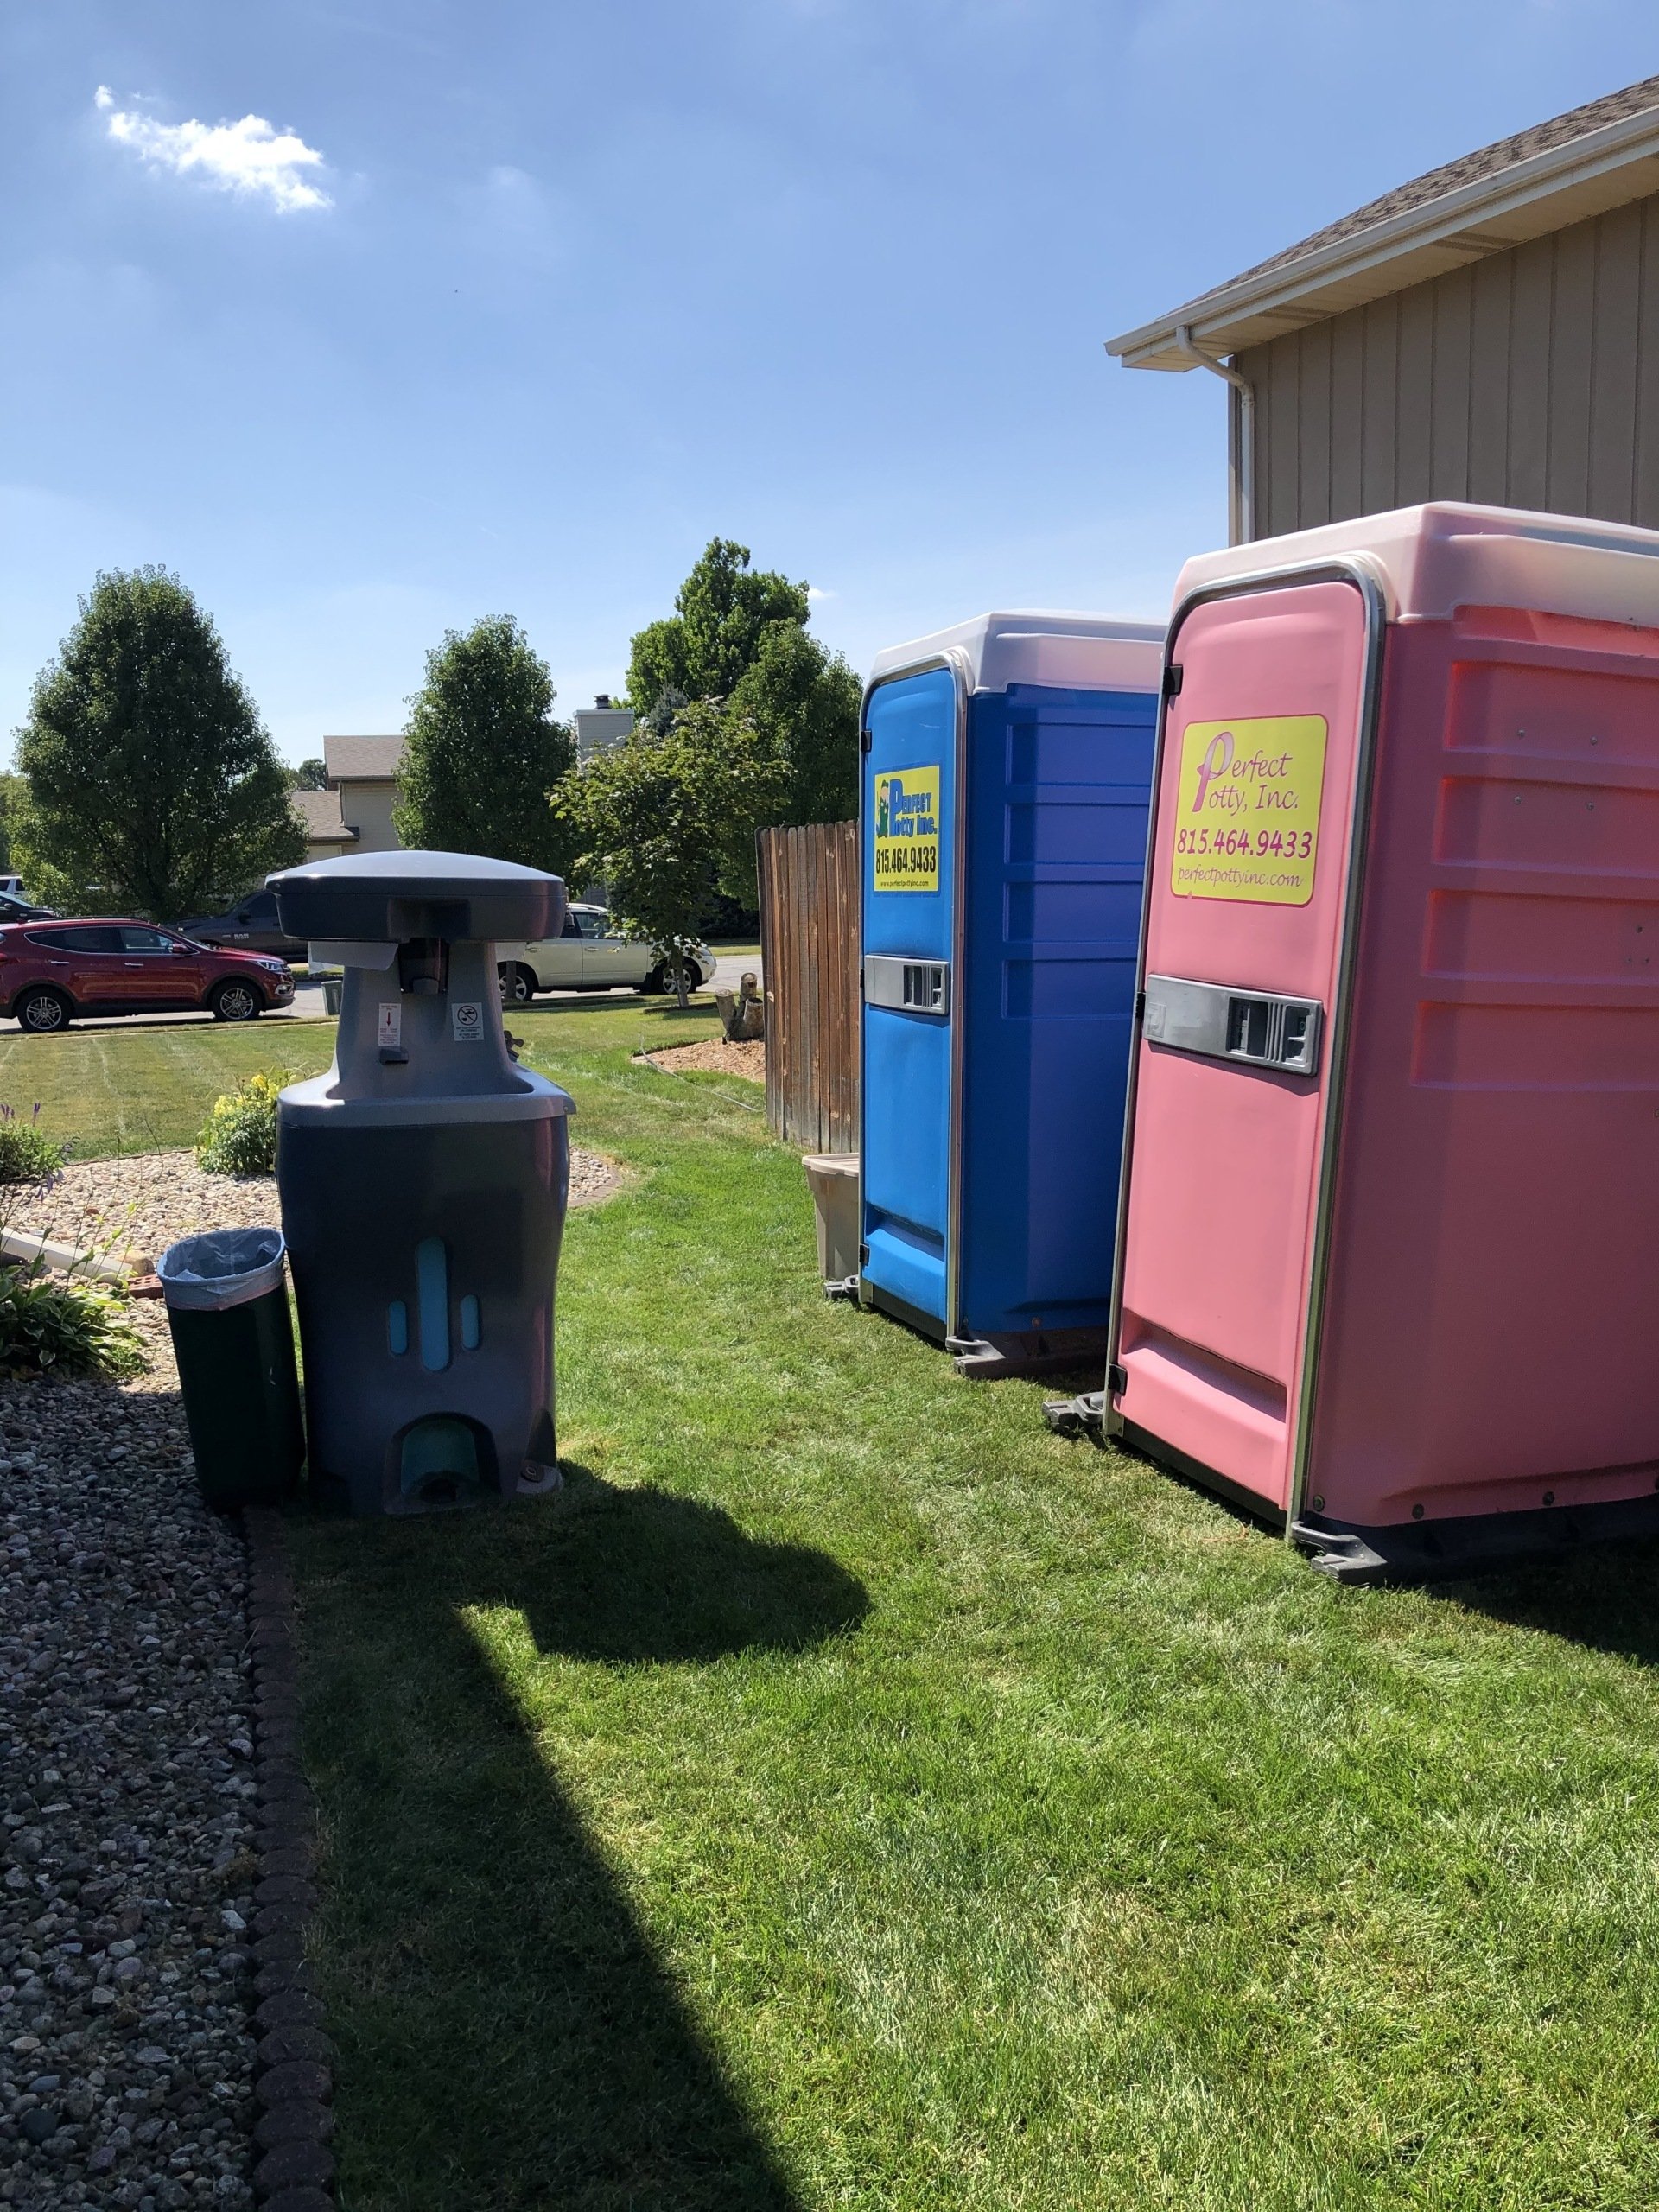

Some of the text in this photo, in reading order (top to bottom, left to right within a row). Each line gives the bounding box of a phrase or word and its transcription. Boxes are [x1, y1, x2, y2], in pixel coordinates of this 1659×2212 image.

[1192, 731, 1293, 812] Perfect
[1255, 784, 1299, 810] Inc.
[1177, 829, 1313, 858] 815.464.9433
[876, 846, 936, 874] 815.464.9433
[1177, 864, 1303, 888] perfectpottyinc.com
